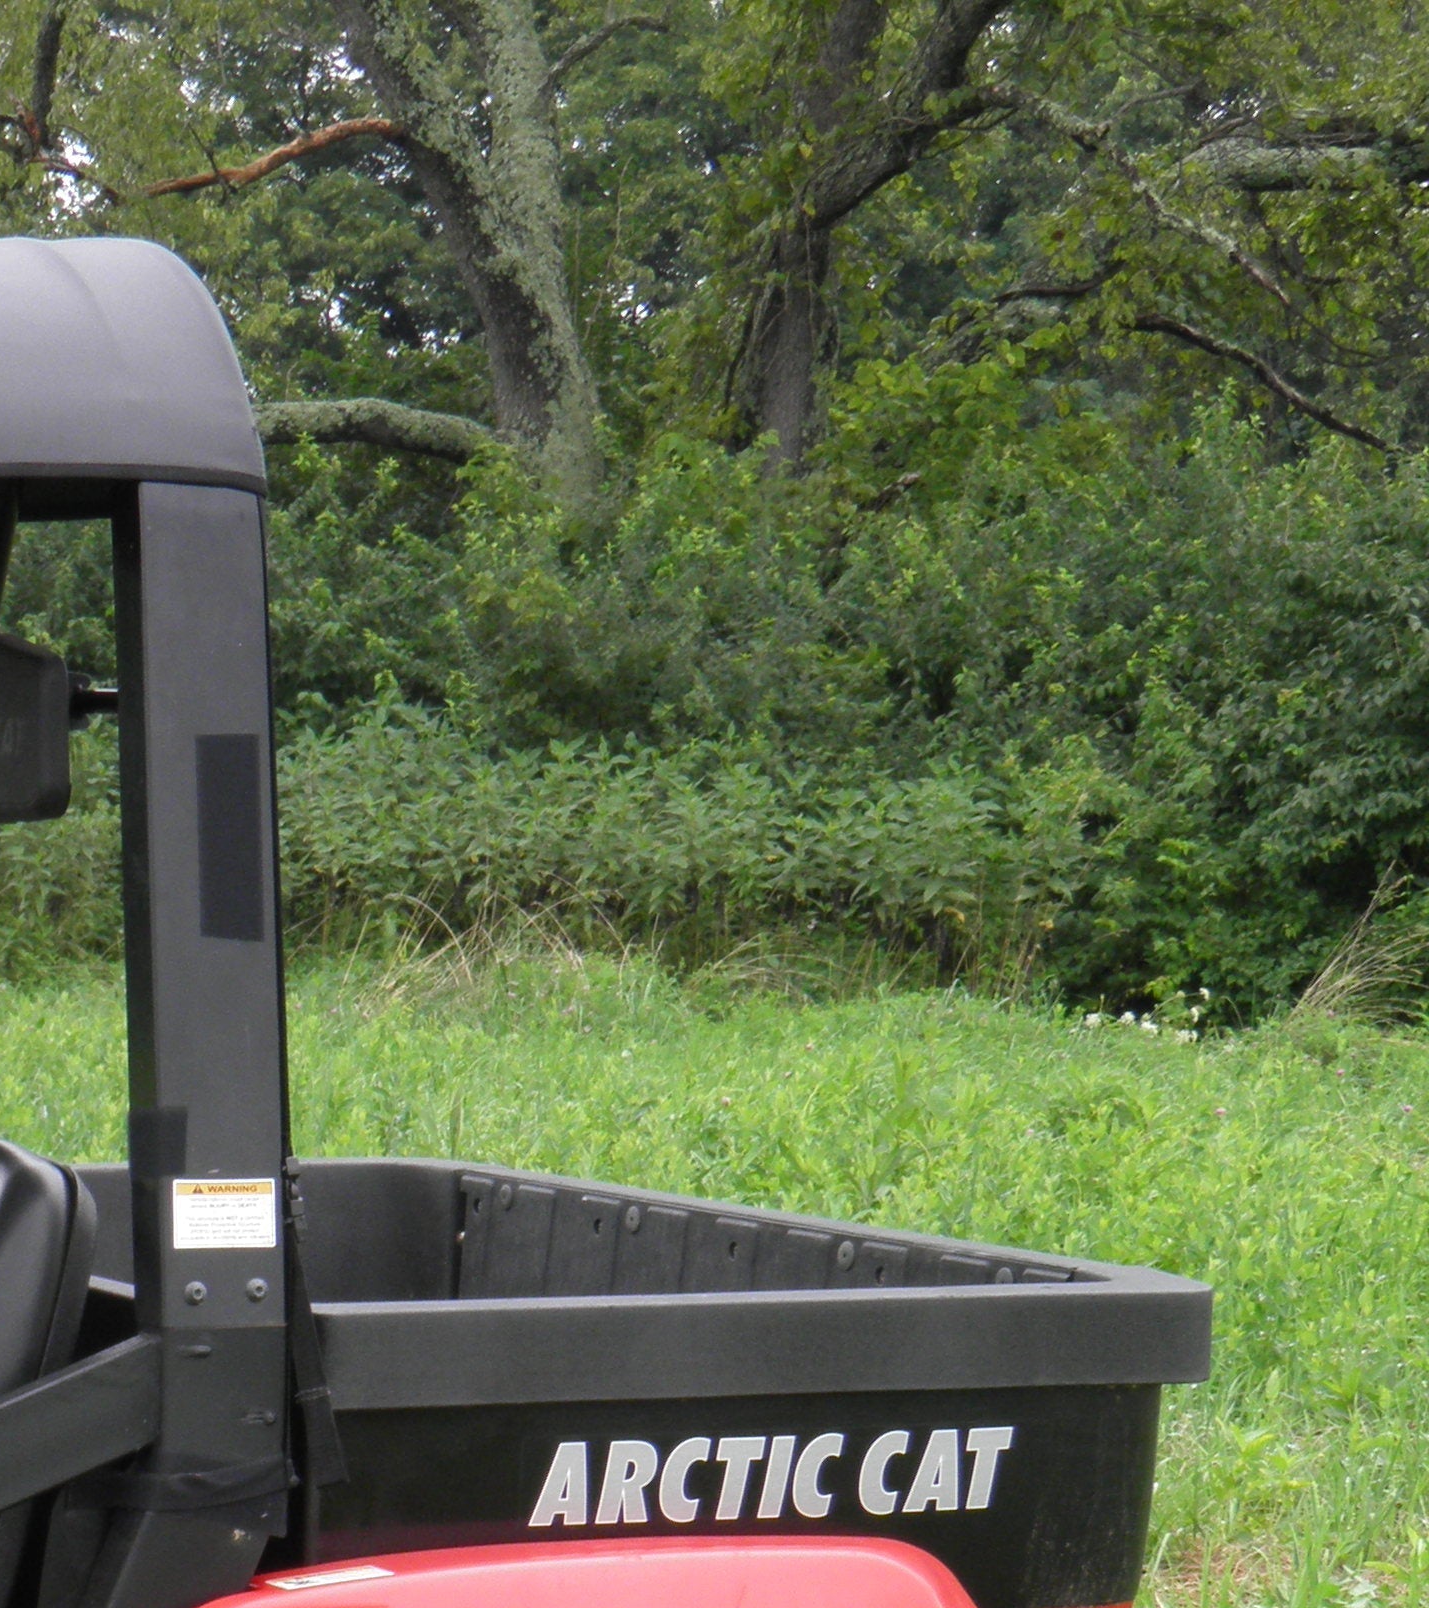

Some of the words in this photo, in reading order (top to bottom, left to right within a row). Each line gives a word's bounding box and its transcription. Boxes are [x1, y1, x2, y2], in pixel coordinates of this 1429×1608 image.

[207, 1184, 258, 1194] WARNING
[528, 1433, 844, 1527] ARCTIC
[858, 1426, 1014, 1516] CAT
